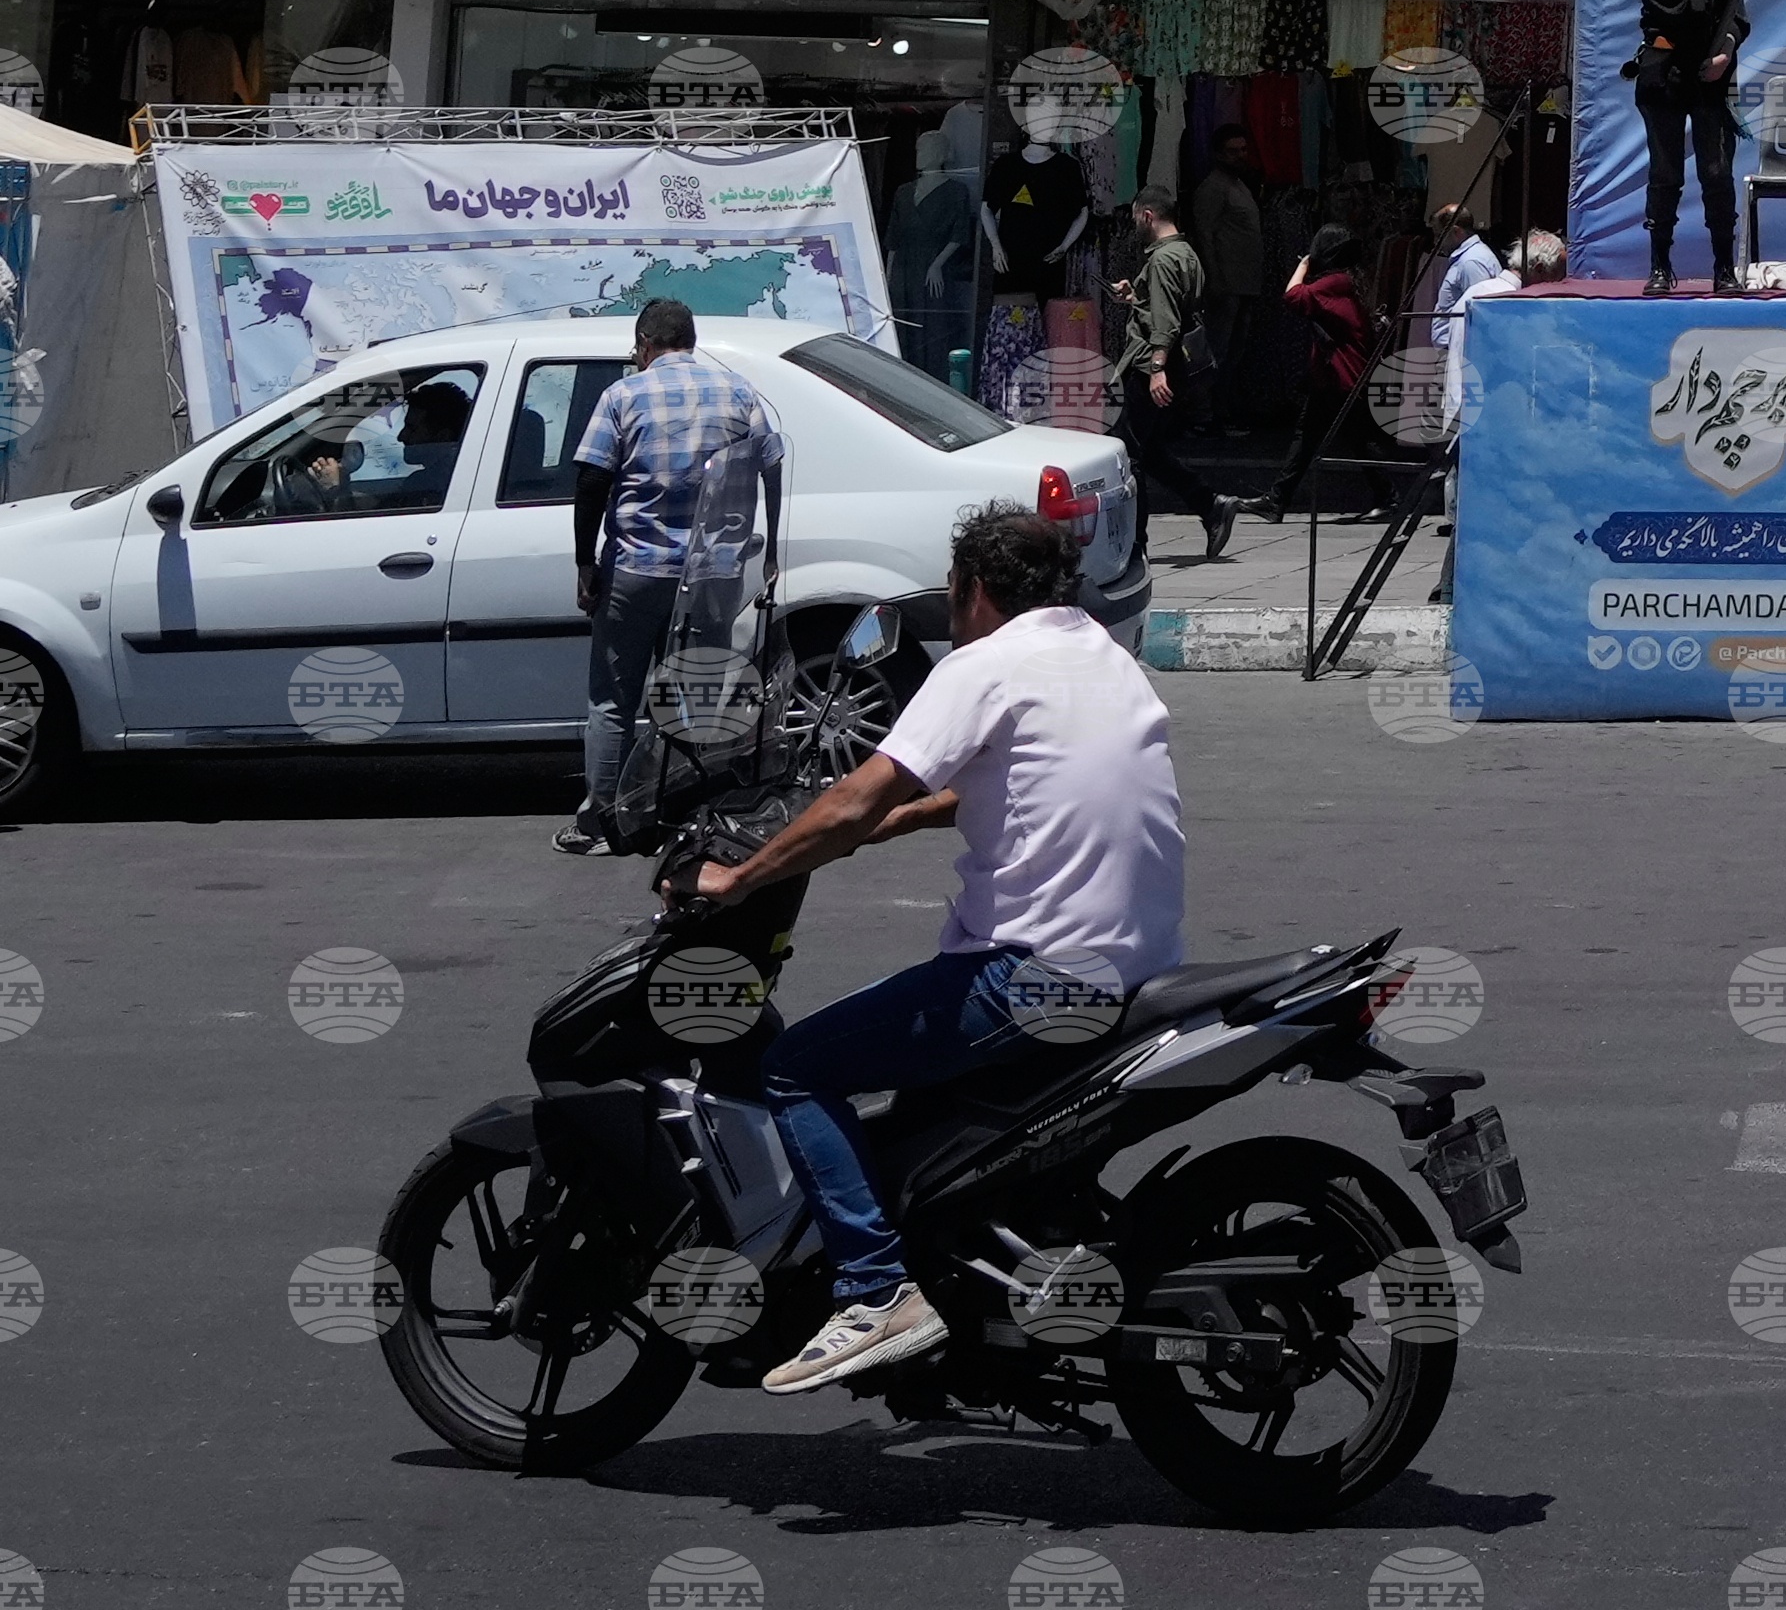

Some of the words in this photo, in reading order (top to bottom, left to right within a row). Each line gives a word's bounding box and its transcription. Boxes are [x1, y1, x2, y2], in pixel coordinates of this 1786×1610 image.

[424, 179, 460, 211] ما
[462, 178, 541, 219] جهان
[544, 188, 562, 218] و
[563, 178, 630, 219] ایران
[719, 187, 738, 204] شو
[740, 186, 766, 203] جنگ
[768, 186, 794, 202] راوی
[1722, 521, 1763, 559] همیشه
[1763, 528, 1777, 547] را
